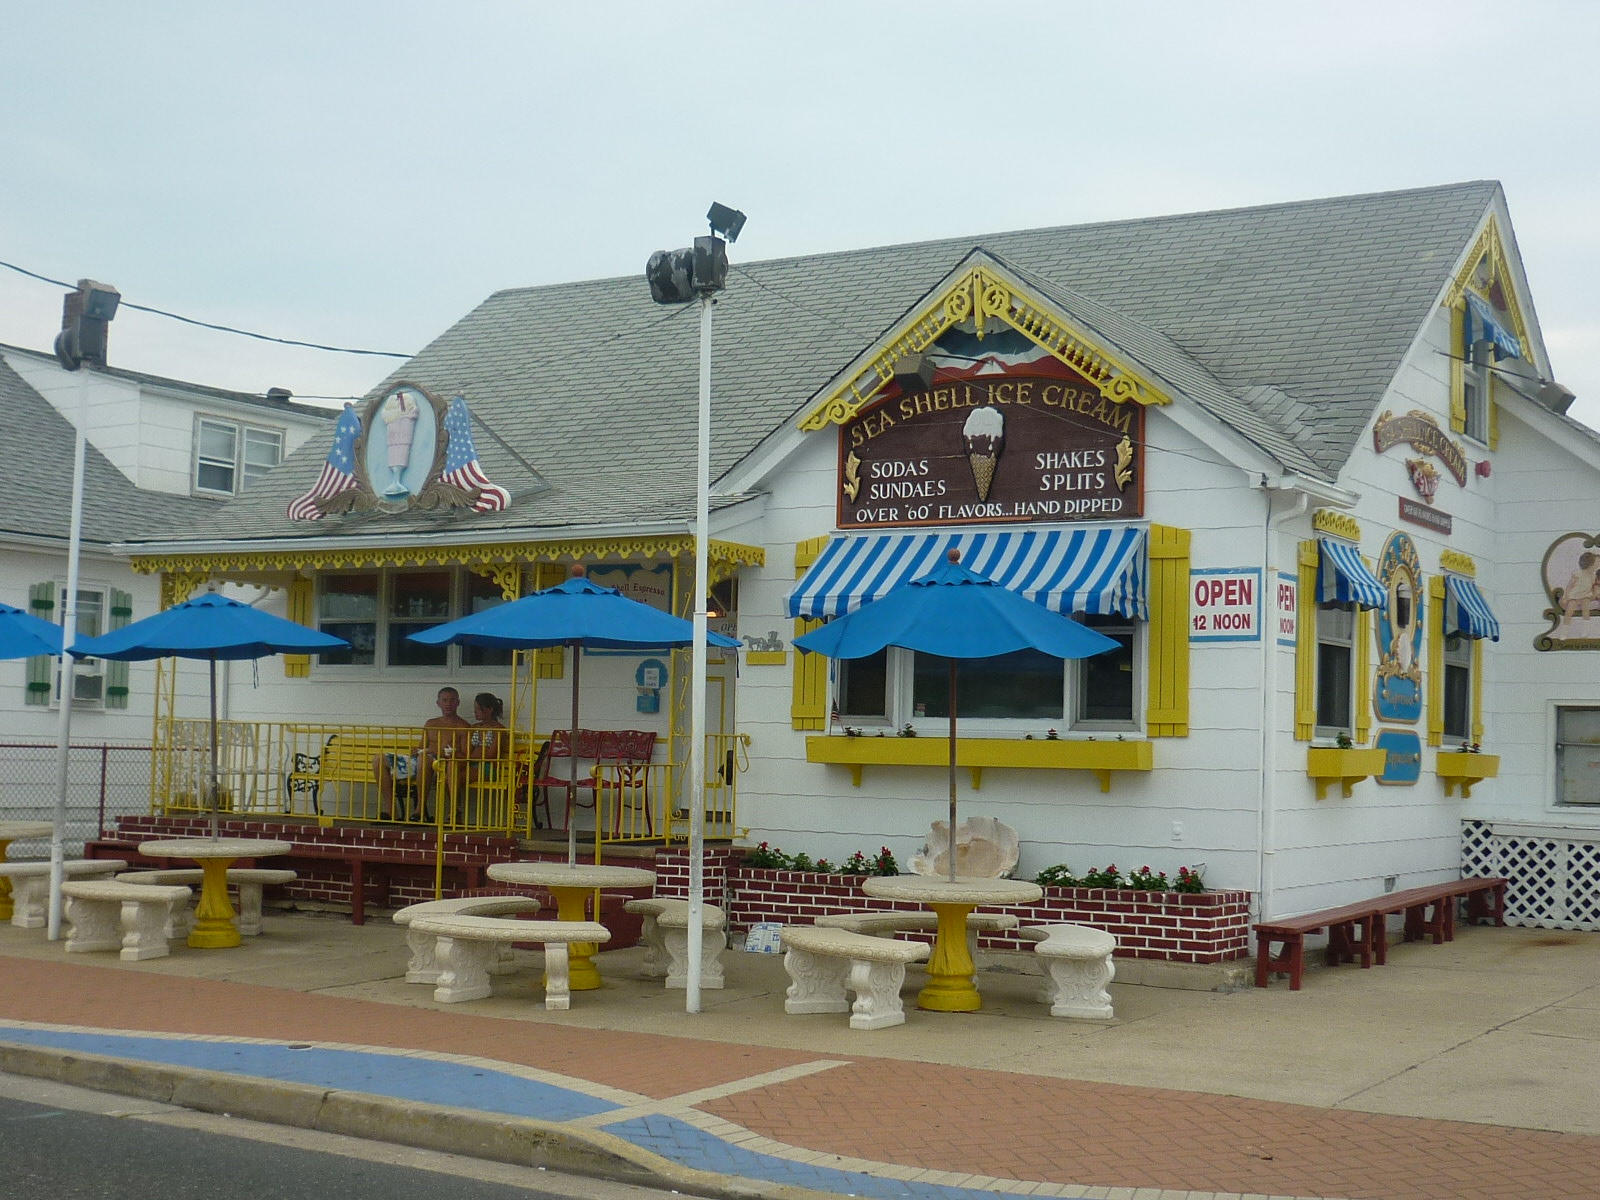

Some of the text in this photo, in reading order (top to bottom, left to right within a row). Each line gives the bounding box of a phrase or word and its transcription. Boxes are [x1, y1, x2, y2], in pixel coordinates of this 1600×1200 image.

[851, 382, 1133, 448] SEA SHELL ICE CREAM
[870, 460, 929, 479] SODAS
[1034, 450, 1105, 470] SHAKES
[870, 480, 946, 500] SUNDAES
[1040, 472, 1105, 491] SPLITS
[856, 508, 899, 522] OVER
[1014, 500, 1060, 516] HAND
[1064, 498, 1123, 513] DIPPED
[633, 582, 665, 596] Espresso
[1194, 579, 1252, 607] OPEN
[1277, 584, 1295, 612] PEN
[1192, 613, 1251, 631] 12 NOON
